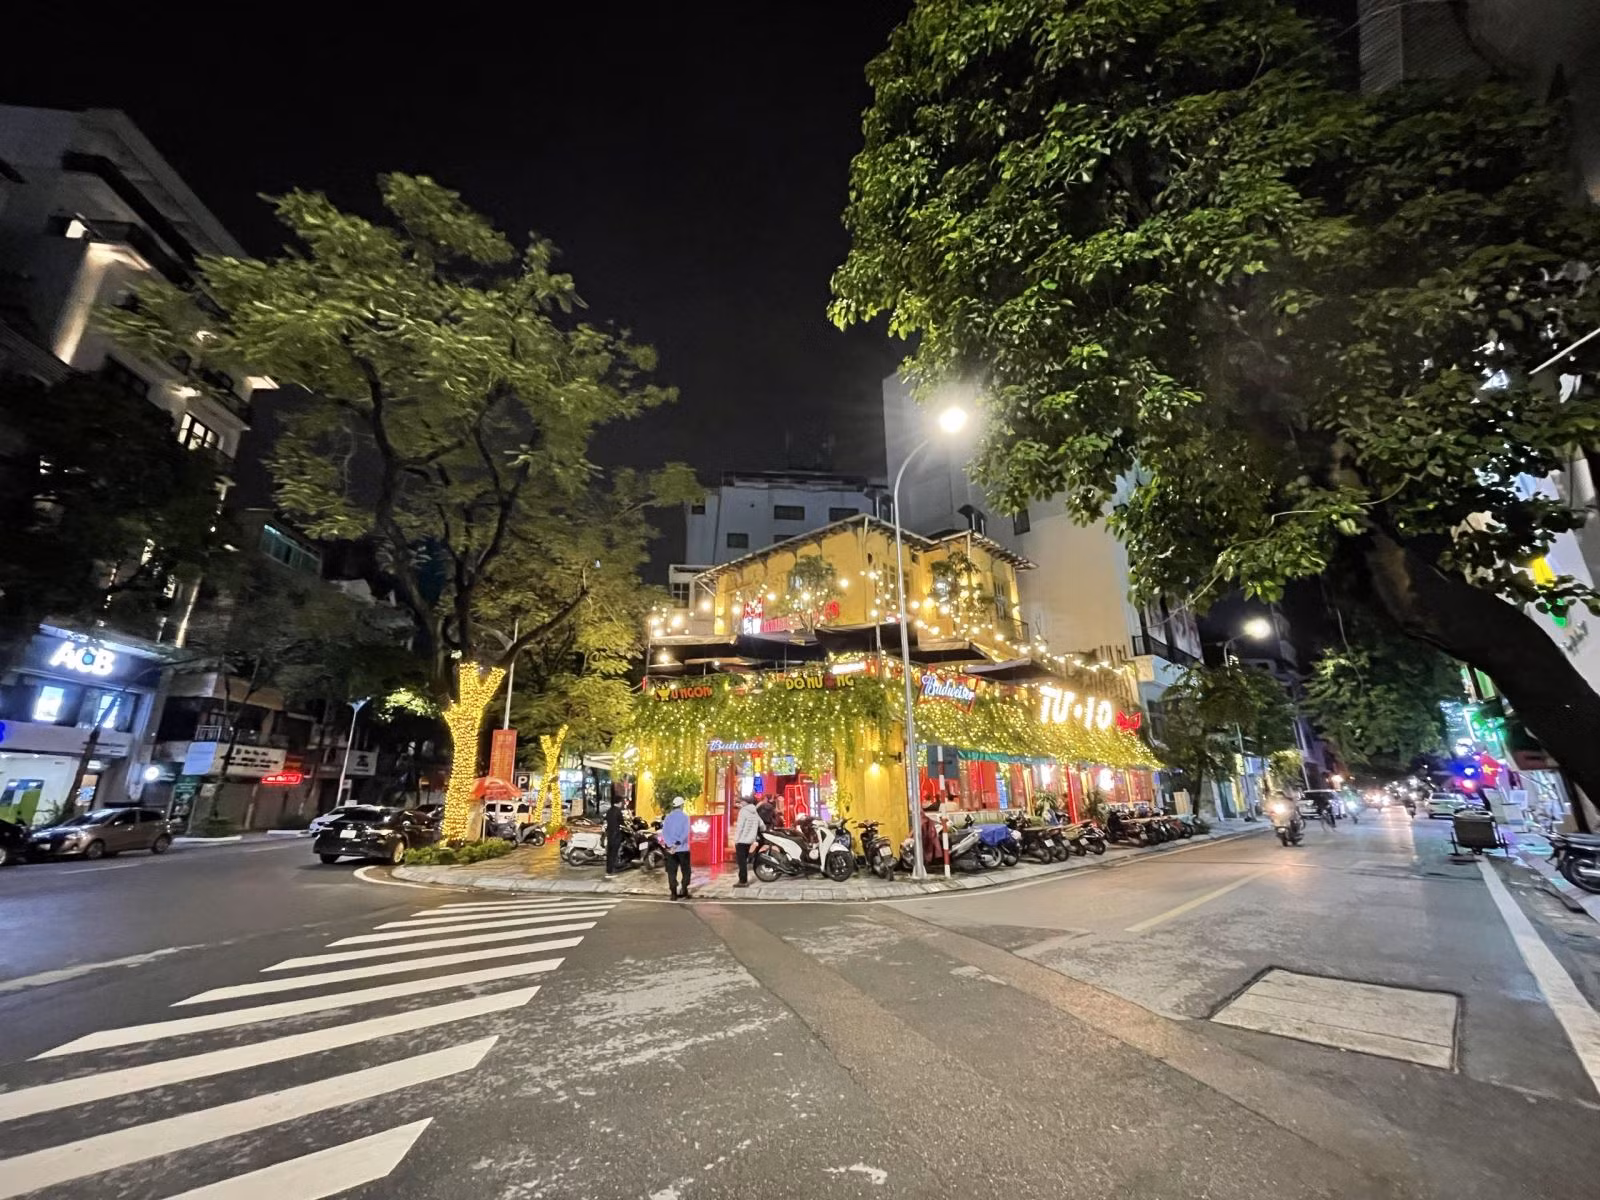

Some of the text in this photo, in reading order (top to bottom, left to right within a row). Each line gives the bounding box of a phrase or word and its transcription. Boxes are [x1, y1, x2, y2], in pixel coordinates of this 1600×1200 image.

[49, 641, 115, 676] ACB
[922, 675, 976, 701] Budweiser
[706, 740, 770, 752] Budweiser
[518, 776, 528, 788] P
